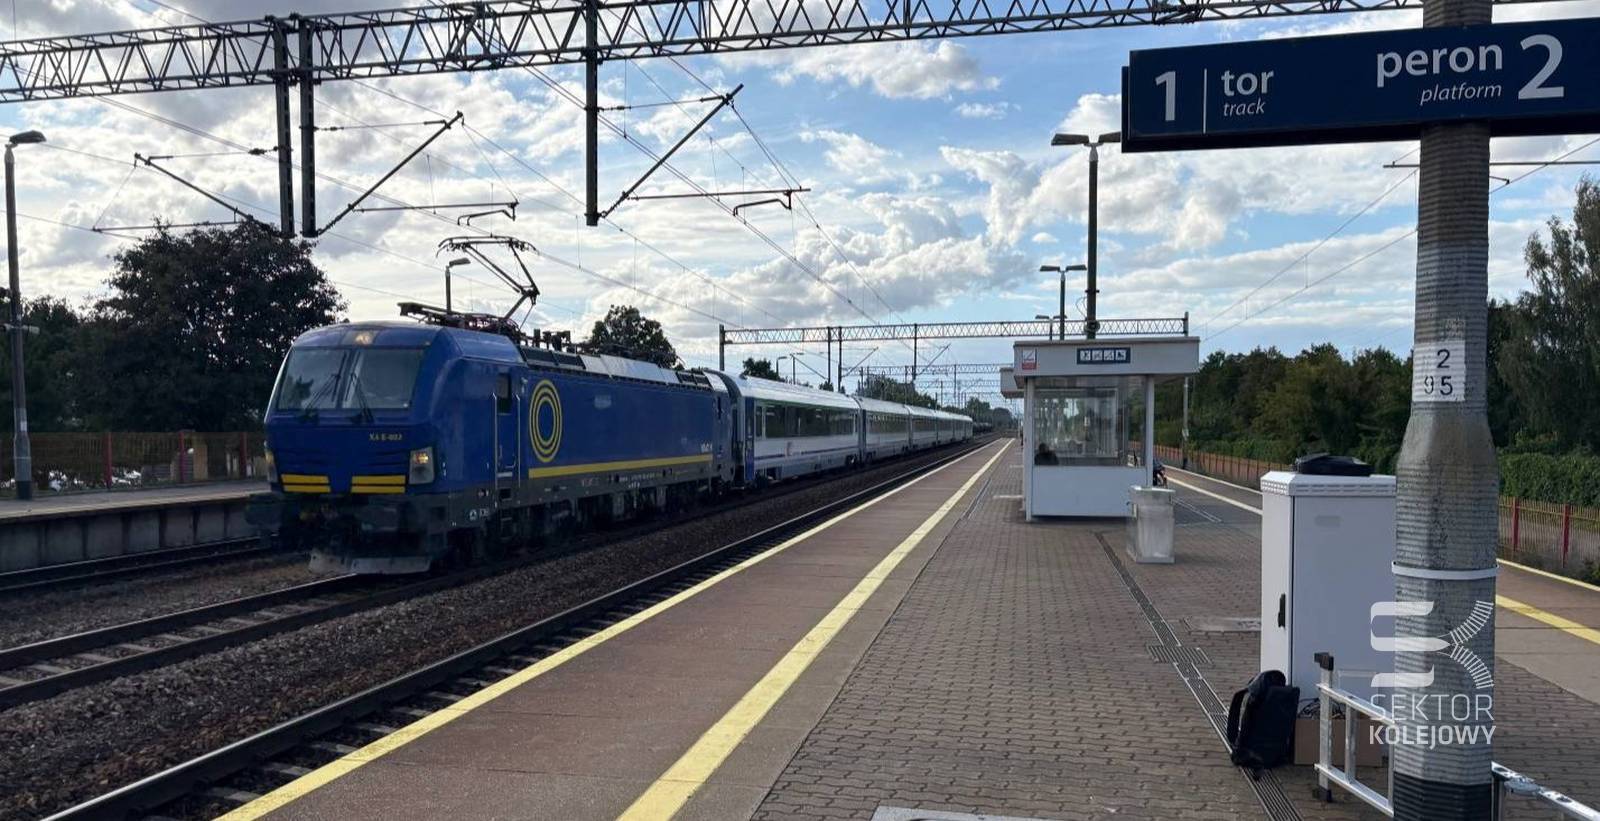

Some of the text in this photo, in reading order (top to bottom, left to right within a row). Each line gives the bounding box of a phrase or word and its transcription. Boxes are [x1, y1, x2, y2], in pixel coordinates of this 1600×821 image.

[1376, 33, 1565, 100] peron 2
[1154, 68, 1274, 121] 1 tor
[1420, 82, 1502, 105] platform
[1223, 98, 1265, 117] track
[1436, 349, 1450, 368] 2
